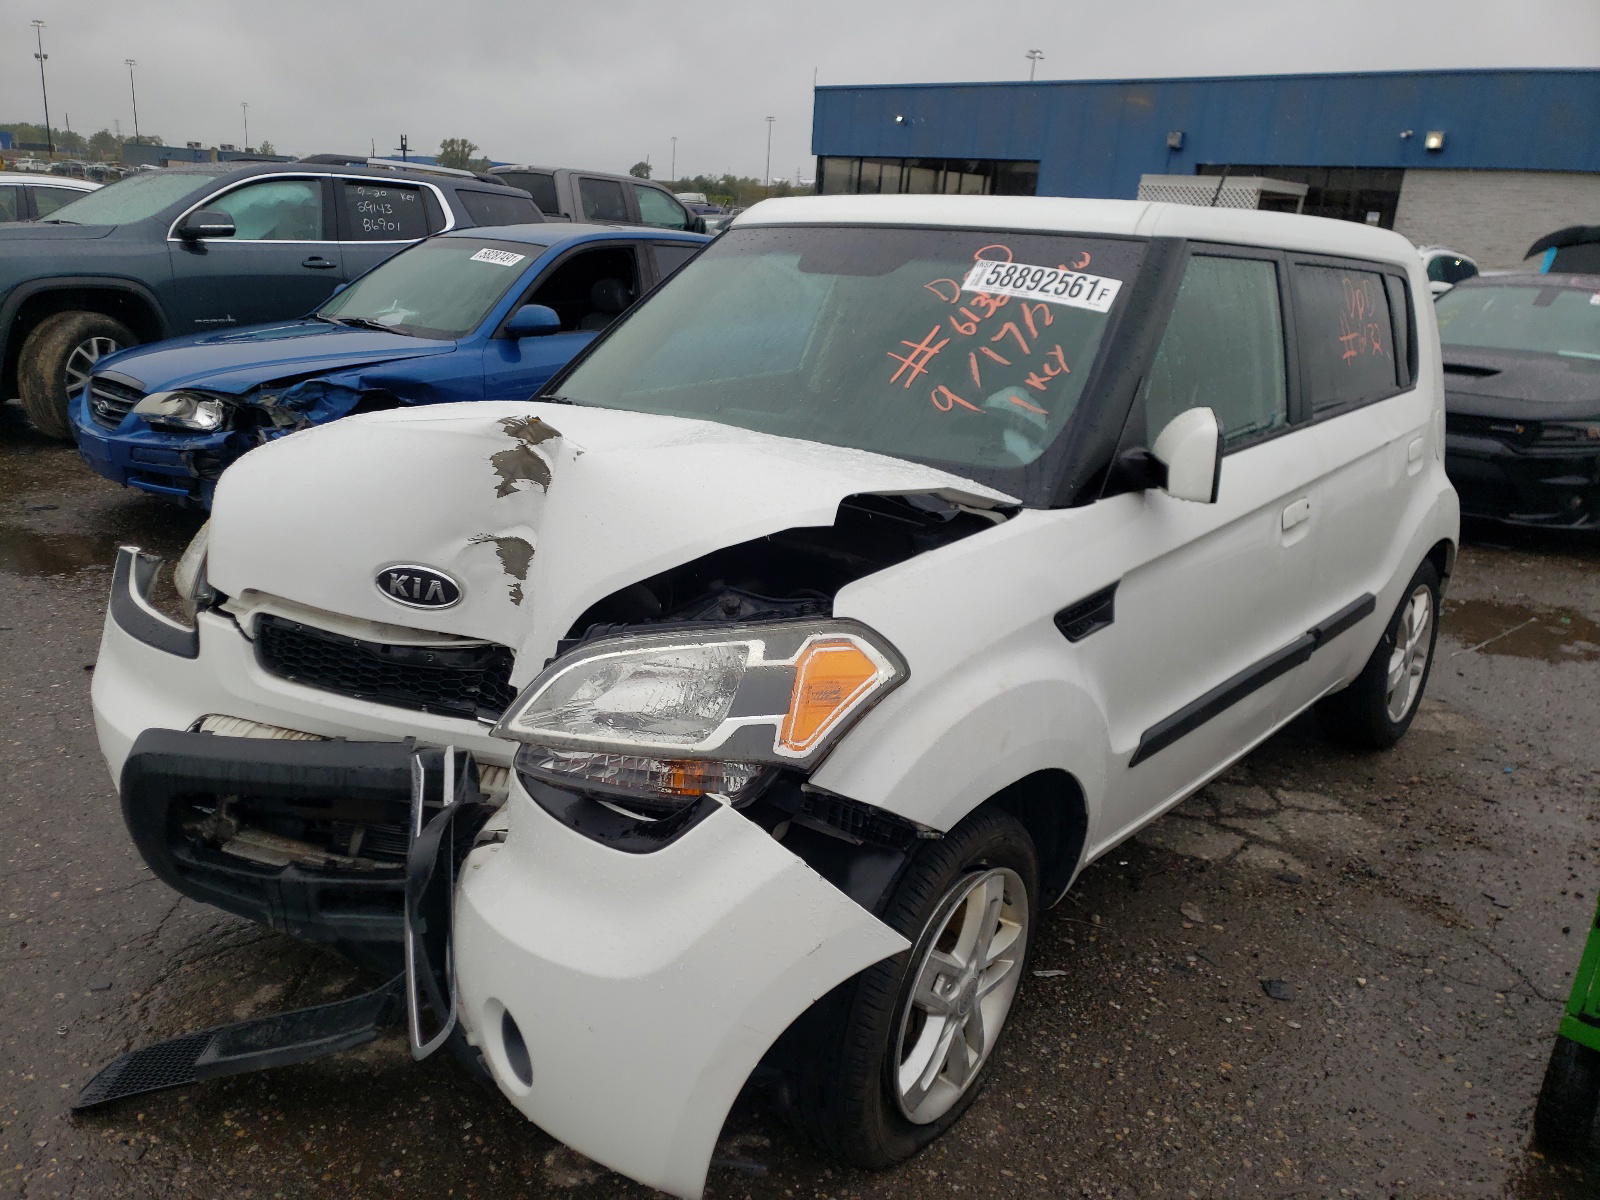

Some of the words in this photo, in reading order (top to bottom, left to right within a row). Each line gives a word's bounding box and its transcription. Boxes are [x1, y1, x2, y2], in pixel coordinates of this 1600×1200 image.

[357, 186, 387, 198] 9-20
[363, 217, 400, 232] 86901
[986, 263, 1100, 302] 58892561
[389, 572, 447, 603] KIA
